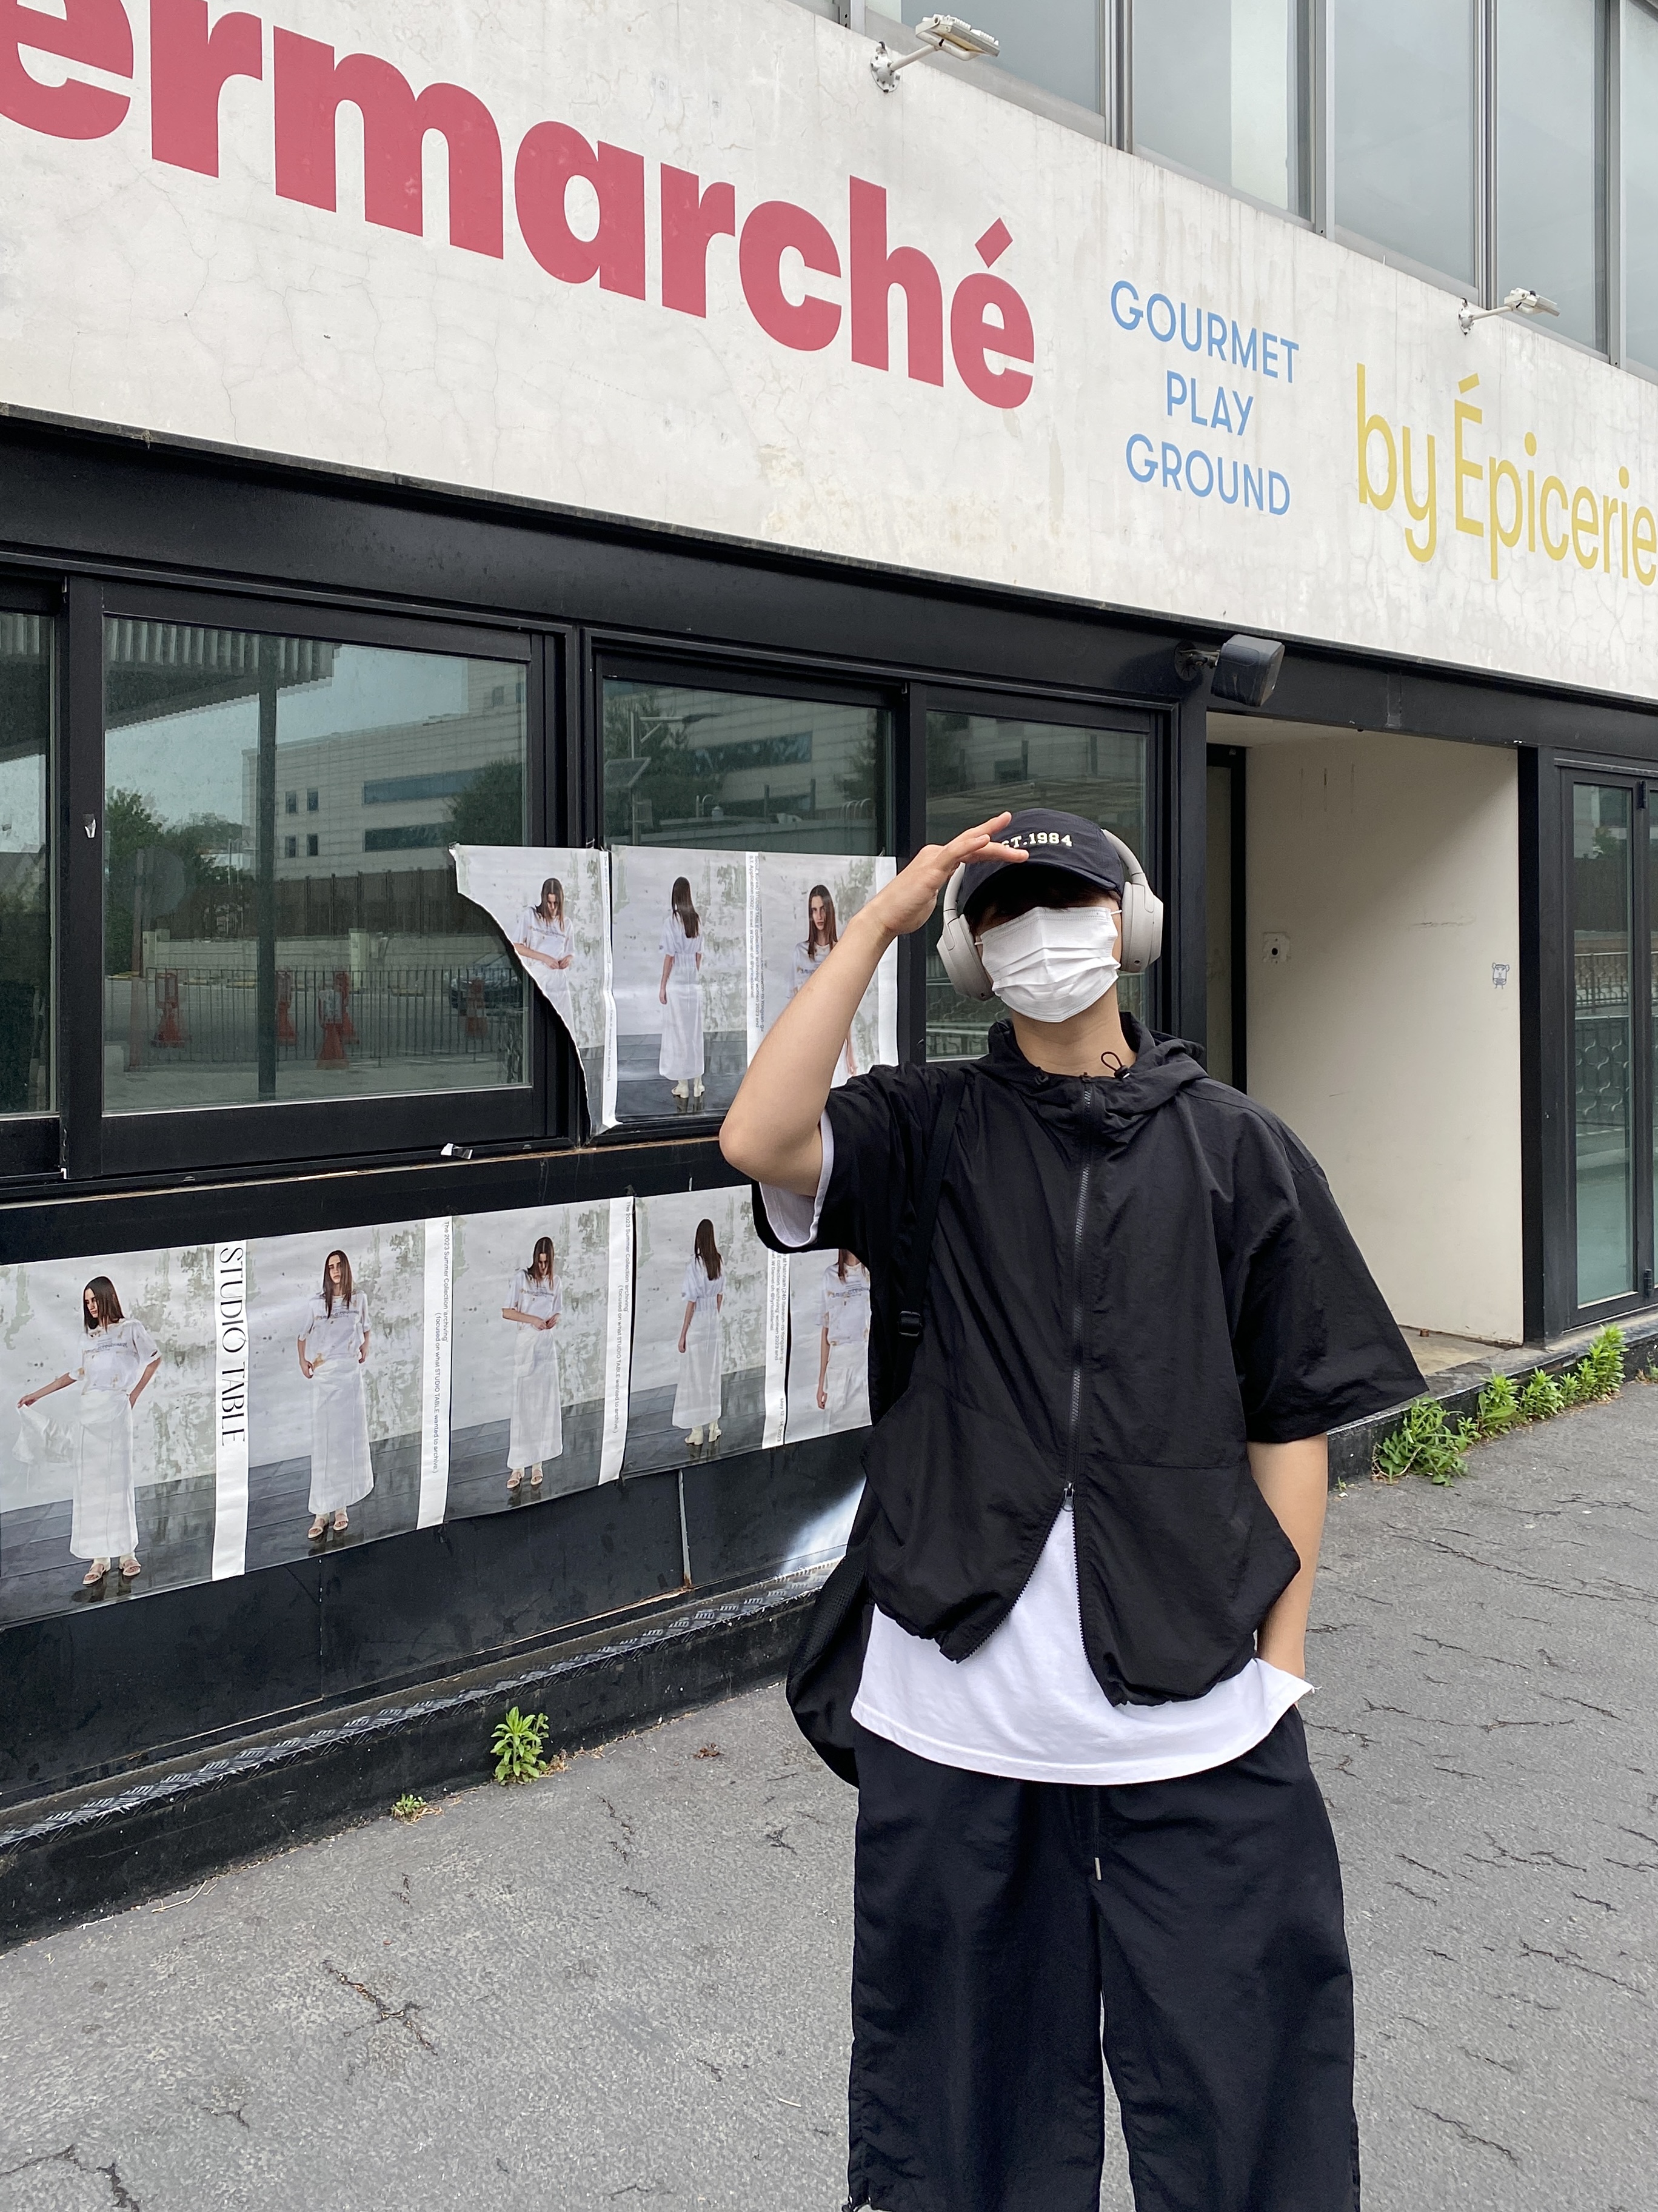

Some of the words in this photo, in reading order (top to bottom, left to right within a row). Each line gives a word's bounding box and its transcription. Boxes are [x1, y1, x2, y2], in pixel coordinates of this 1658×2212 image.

[1111, 281, 1299, 384] GOURMET
[1167, 370, 1254, 436] PLAY
[1126, 433, 1291, 515] GROUND
[1357, 363, 1437, 563] by
[1455, 373, 1657, 586] Épicerie
[219, 1245, 249, 1354] STUDIO
[435, 1342, 440, 1351] on
[221, 1361, 249, 1446] TABLE
